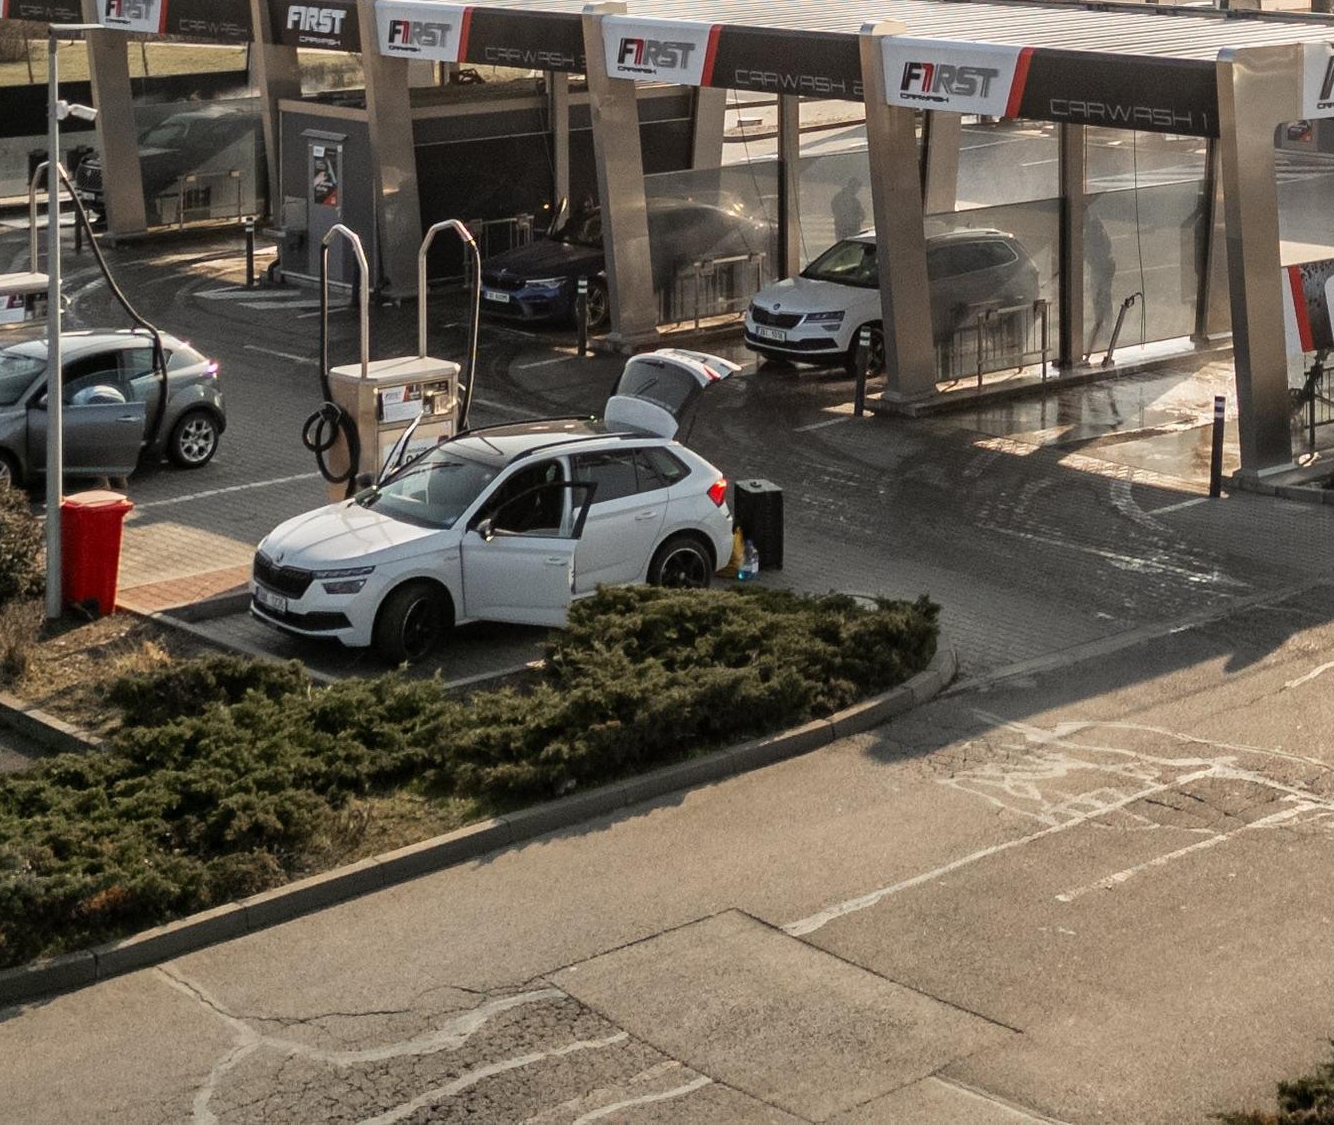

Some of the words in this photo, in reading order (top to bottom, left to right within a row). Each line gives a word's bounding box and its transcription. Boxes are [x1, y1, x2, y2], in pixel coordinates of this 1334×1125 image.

[485, 47, 575, 68] CARWASH
[734, 69, 847, 94] CARWASH
[899, 91, 949, 103] CARWASH
[1050, 98, 1191, 127] CARWASH
